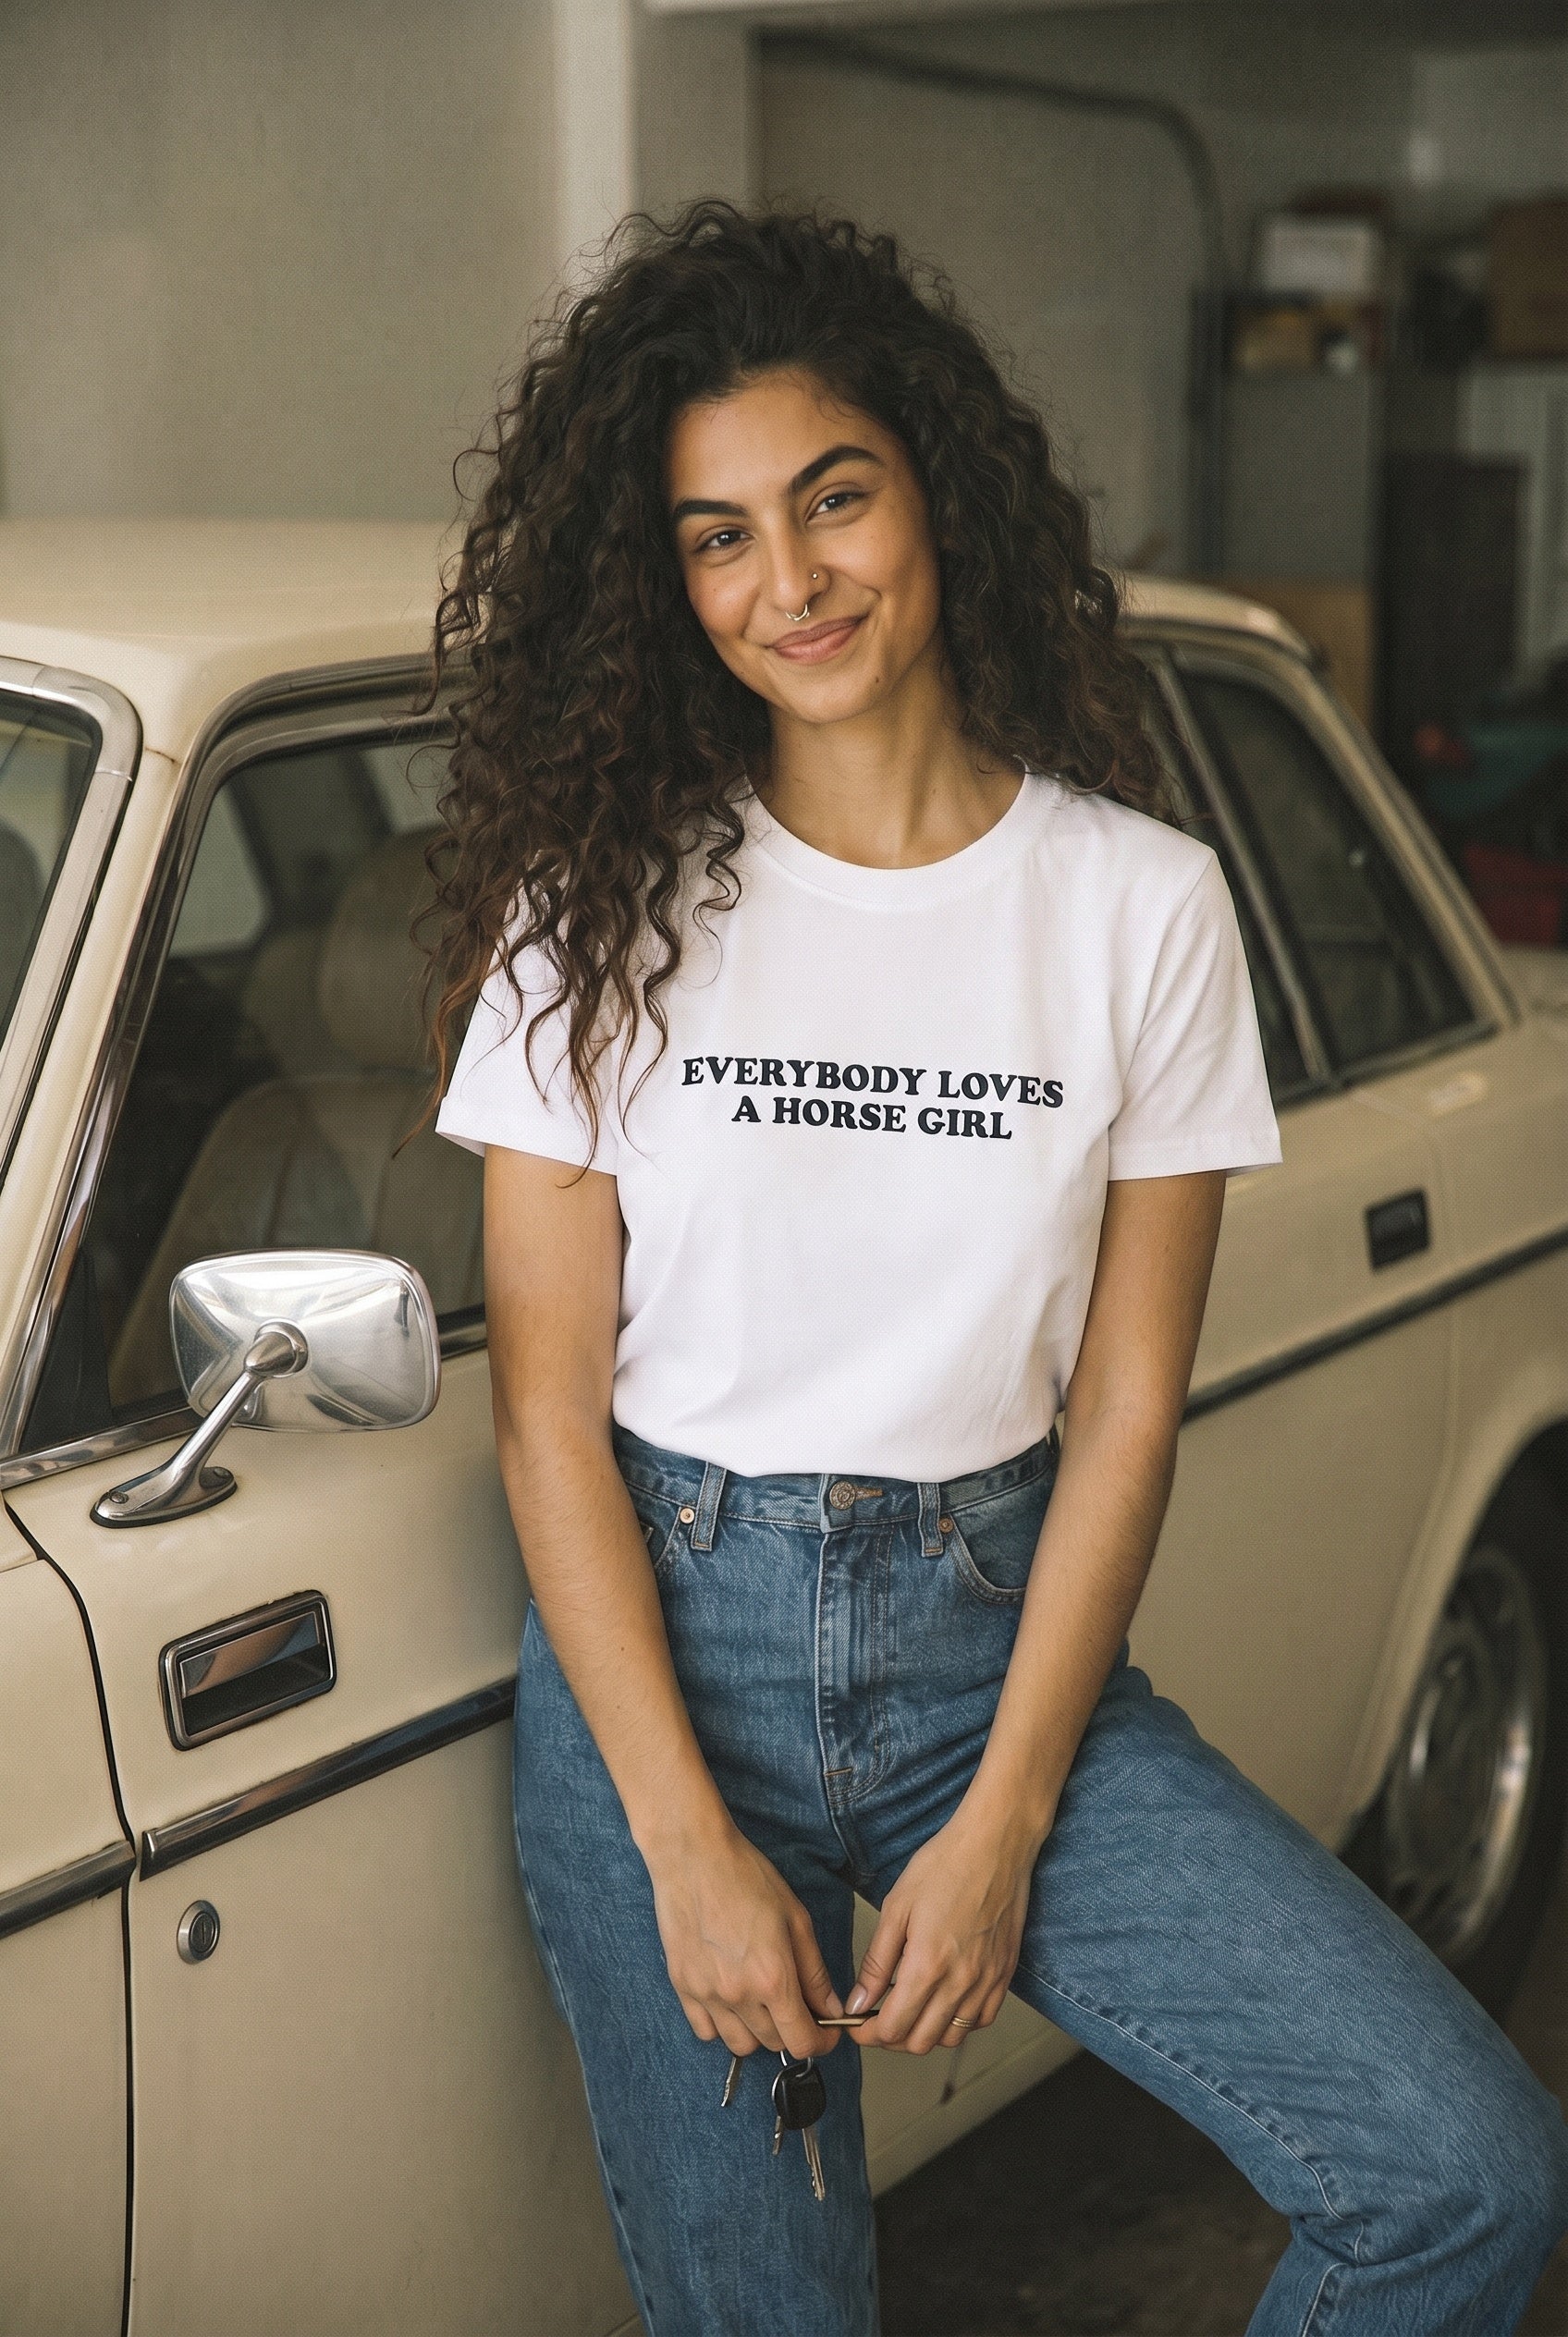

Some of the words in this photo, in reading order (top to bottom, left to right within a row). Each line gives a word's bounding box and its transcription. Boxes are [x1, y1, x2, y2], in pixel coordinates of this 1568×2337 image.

[681, 1056, 927, 1095] EVERYBODY
[937, 1071, 1064, 1108] LOVES
[731, 1095, 762, 1123] A
[772, 1096, 907, 1133] HORSE
[917, 1107, 1012, 1140] GIRL
